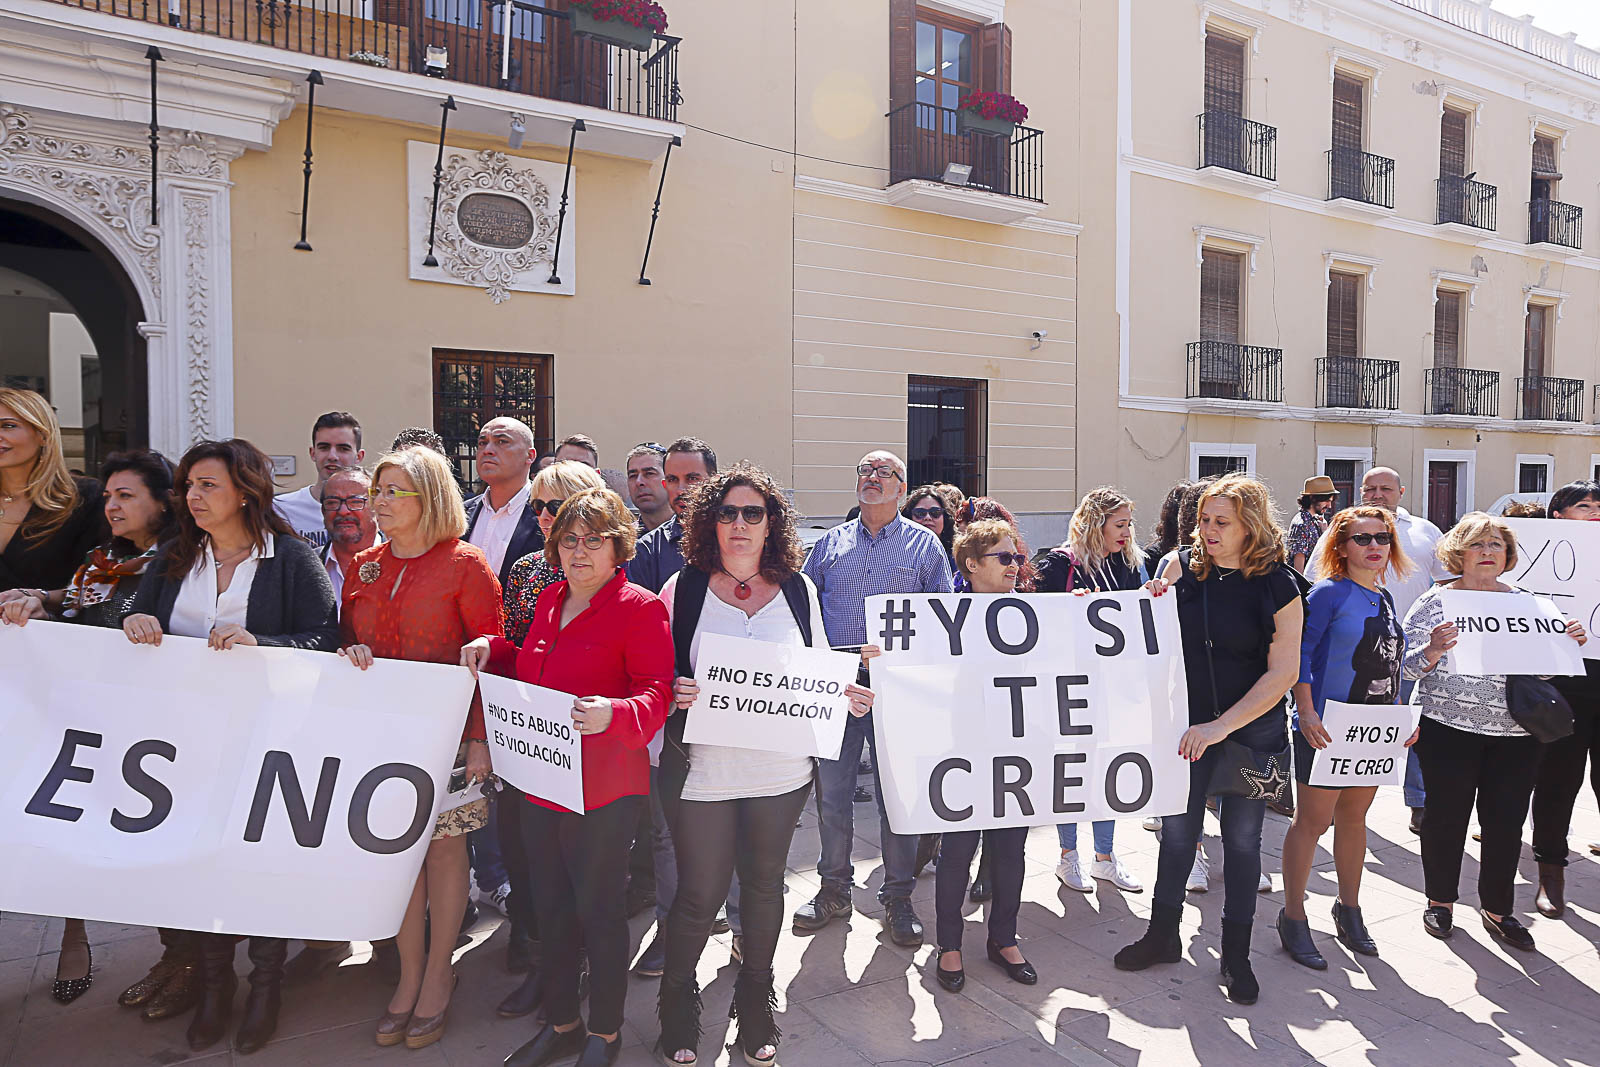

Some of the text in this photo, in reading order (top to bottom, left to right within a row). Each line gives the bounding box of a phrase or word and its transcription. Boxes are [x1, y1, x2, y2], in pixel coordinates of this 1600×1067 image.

[879, 597, 1159, 657] #YO SI
[1455, 616, 1567, 634] #NO ES NO
[707, 665, 843, 698] #NO ES ABUSO,
[488, 702, 574, 745] #NO ES ABUSO,
[709, 694, 833, 721] ES VIOLACIÓN
[993, 674, 1093, 738] TE
[494, 729, 571, 770] ES VIOLACIÓN
[1345, 725, 1399, 743] #YO SI
[928, 751, 1154, 822] CREO
[1330, 757, 1394, 776] TE CREO
[25, 728, 435, 855] ES NO
